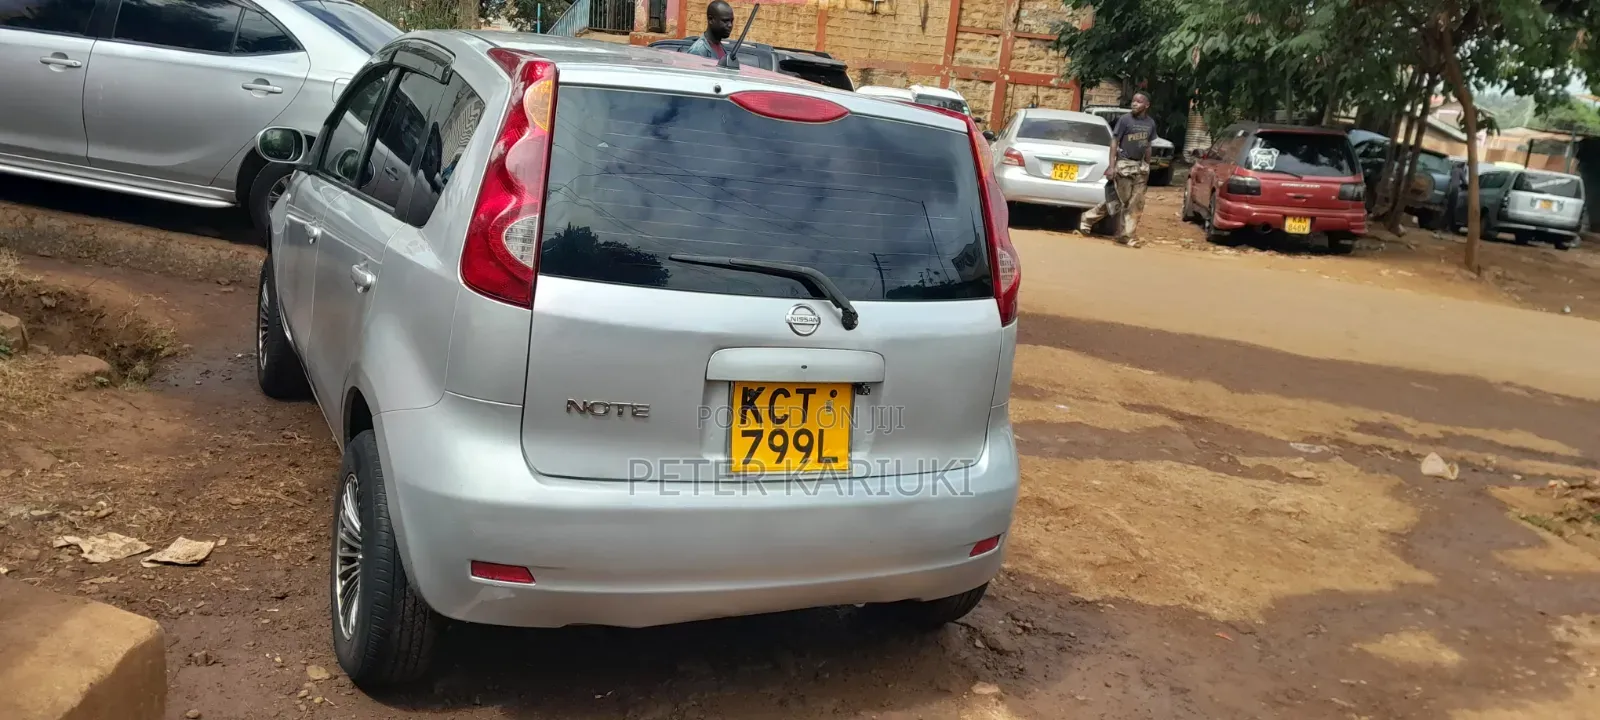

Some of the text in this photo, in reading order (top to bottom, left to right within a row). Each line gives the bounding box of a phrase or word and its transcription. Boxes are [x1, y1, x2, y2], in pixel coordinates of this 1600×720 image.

[1053, 163, 1071, 172] KCJ
[566, 398, 650, 417] NOTE
[740, 386, 816, 425] KCT
[740, 428, 839, 465] 799L
